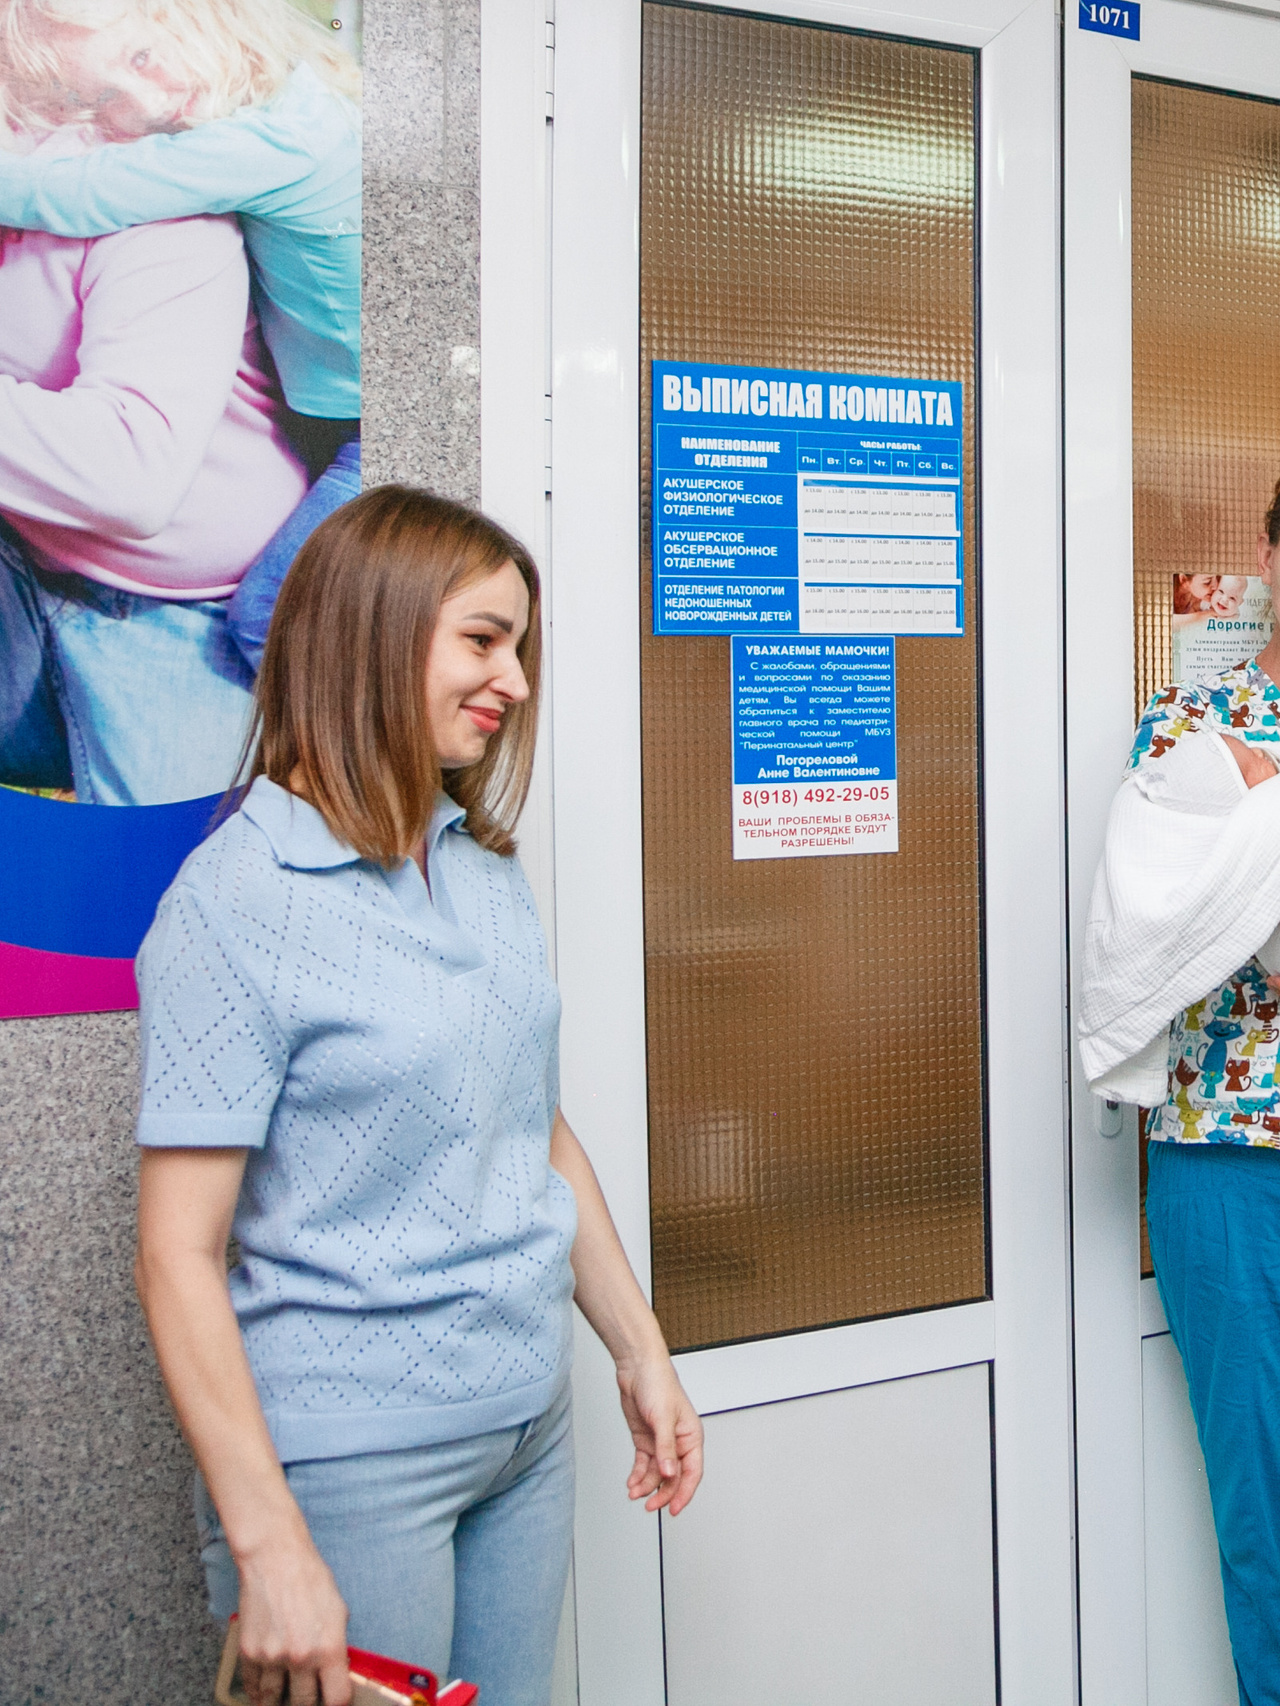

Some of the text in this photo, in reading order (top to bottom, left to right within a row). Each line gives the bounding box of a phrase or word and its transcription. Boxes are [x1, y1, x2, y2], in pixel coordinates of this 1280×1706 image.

[1090, 4, 1130, 29] 1071
[663, 374, 953, 426] ВЫПИСНАЯ КОМНАТА
[681, 437, 780, 454] НАИМЕНОВАНИЕ
[860, 440, 922, 451] ЧАСЫ РАБОТЫ:
[695, 453, 767, 468] ОТДЕЛЕНИЯ
[802, 456, 818, 464] Пн.
[828, 457, 841, 465] Вт.
[850, 457, 865, 467] Ср.
[897, 460, 910, 468] Пт.
[918, 461, 934, 469] Сб.
[663, 478, 744, 490] АКУШЕРСКОЕ
[663, 491, 783, 505] ФИЗИОЛОГИЧЕСКОЕ
[664, 505, 734, 517] ОТДЕЛЕНИЕ
[664, 532, 744, 542] АКУШЕРСКОЕ
[664, 545, 778, 557] ОБСЕРВАЦИОННОЕ
[664, 557, 735, 569] ОТДЕЛЕНИЕ
[665, 585, 784, 596] ОТДЕЛЕНИЕ ПАТОЛОГИИ
[665, 598, 751, 609] НЕДОНОШЕННЫХ
[665, 611, 757, 621] НОВОРОЖДЕННЫХ
[760, 610, 791, 622] ДЕТЕЙ
[1207, 619, 1264, 632] Дорогие
[746, 646, 889, 655] УВАЖАЕМЫЕ МАМОЧКИ!
[762, 662, 817, 671] жалобами,
[821, 662, 890, 670] обращениями
[755, 674, 812, 682] вопросами
[739, 685, 806, 693] медицинской
[739, 697, 771, 705] детям,
[739, 707, 797, 716] обратиться
[841, 719, 889, 728] педиатри-
[740, 730, 775, 738] ческой
[777, 754, 857, 767] Погореловой
[758, 767, 880, 779] Анне Валентиновне
[743, 787, 889, 808] 8(918) 492-29-05
[739, 818, 771, 826] ВАШИ
[778, 816, 841, 825] ПРОБЛЕМЫ
[855, 813, 894, 822] ОБЯЗА-
[744, 824, 887, 838] ТЕЛЬНОМ ПОРЯДКЕ БУДУТ
[781, 837, 854, 847] РАЗРЕШЕНЫ!
